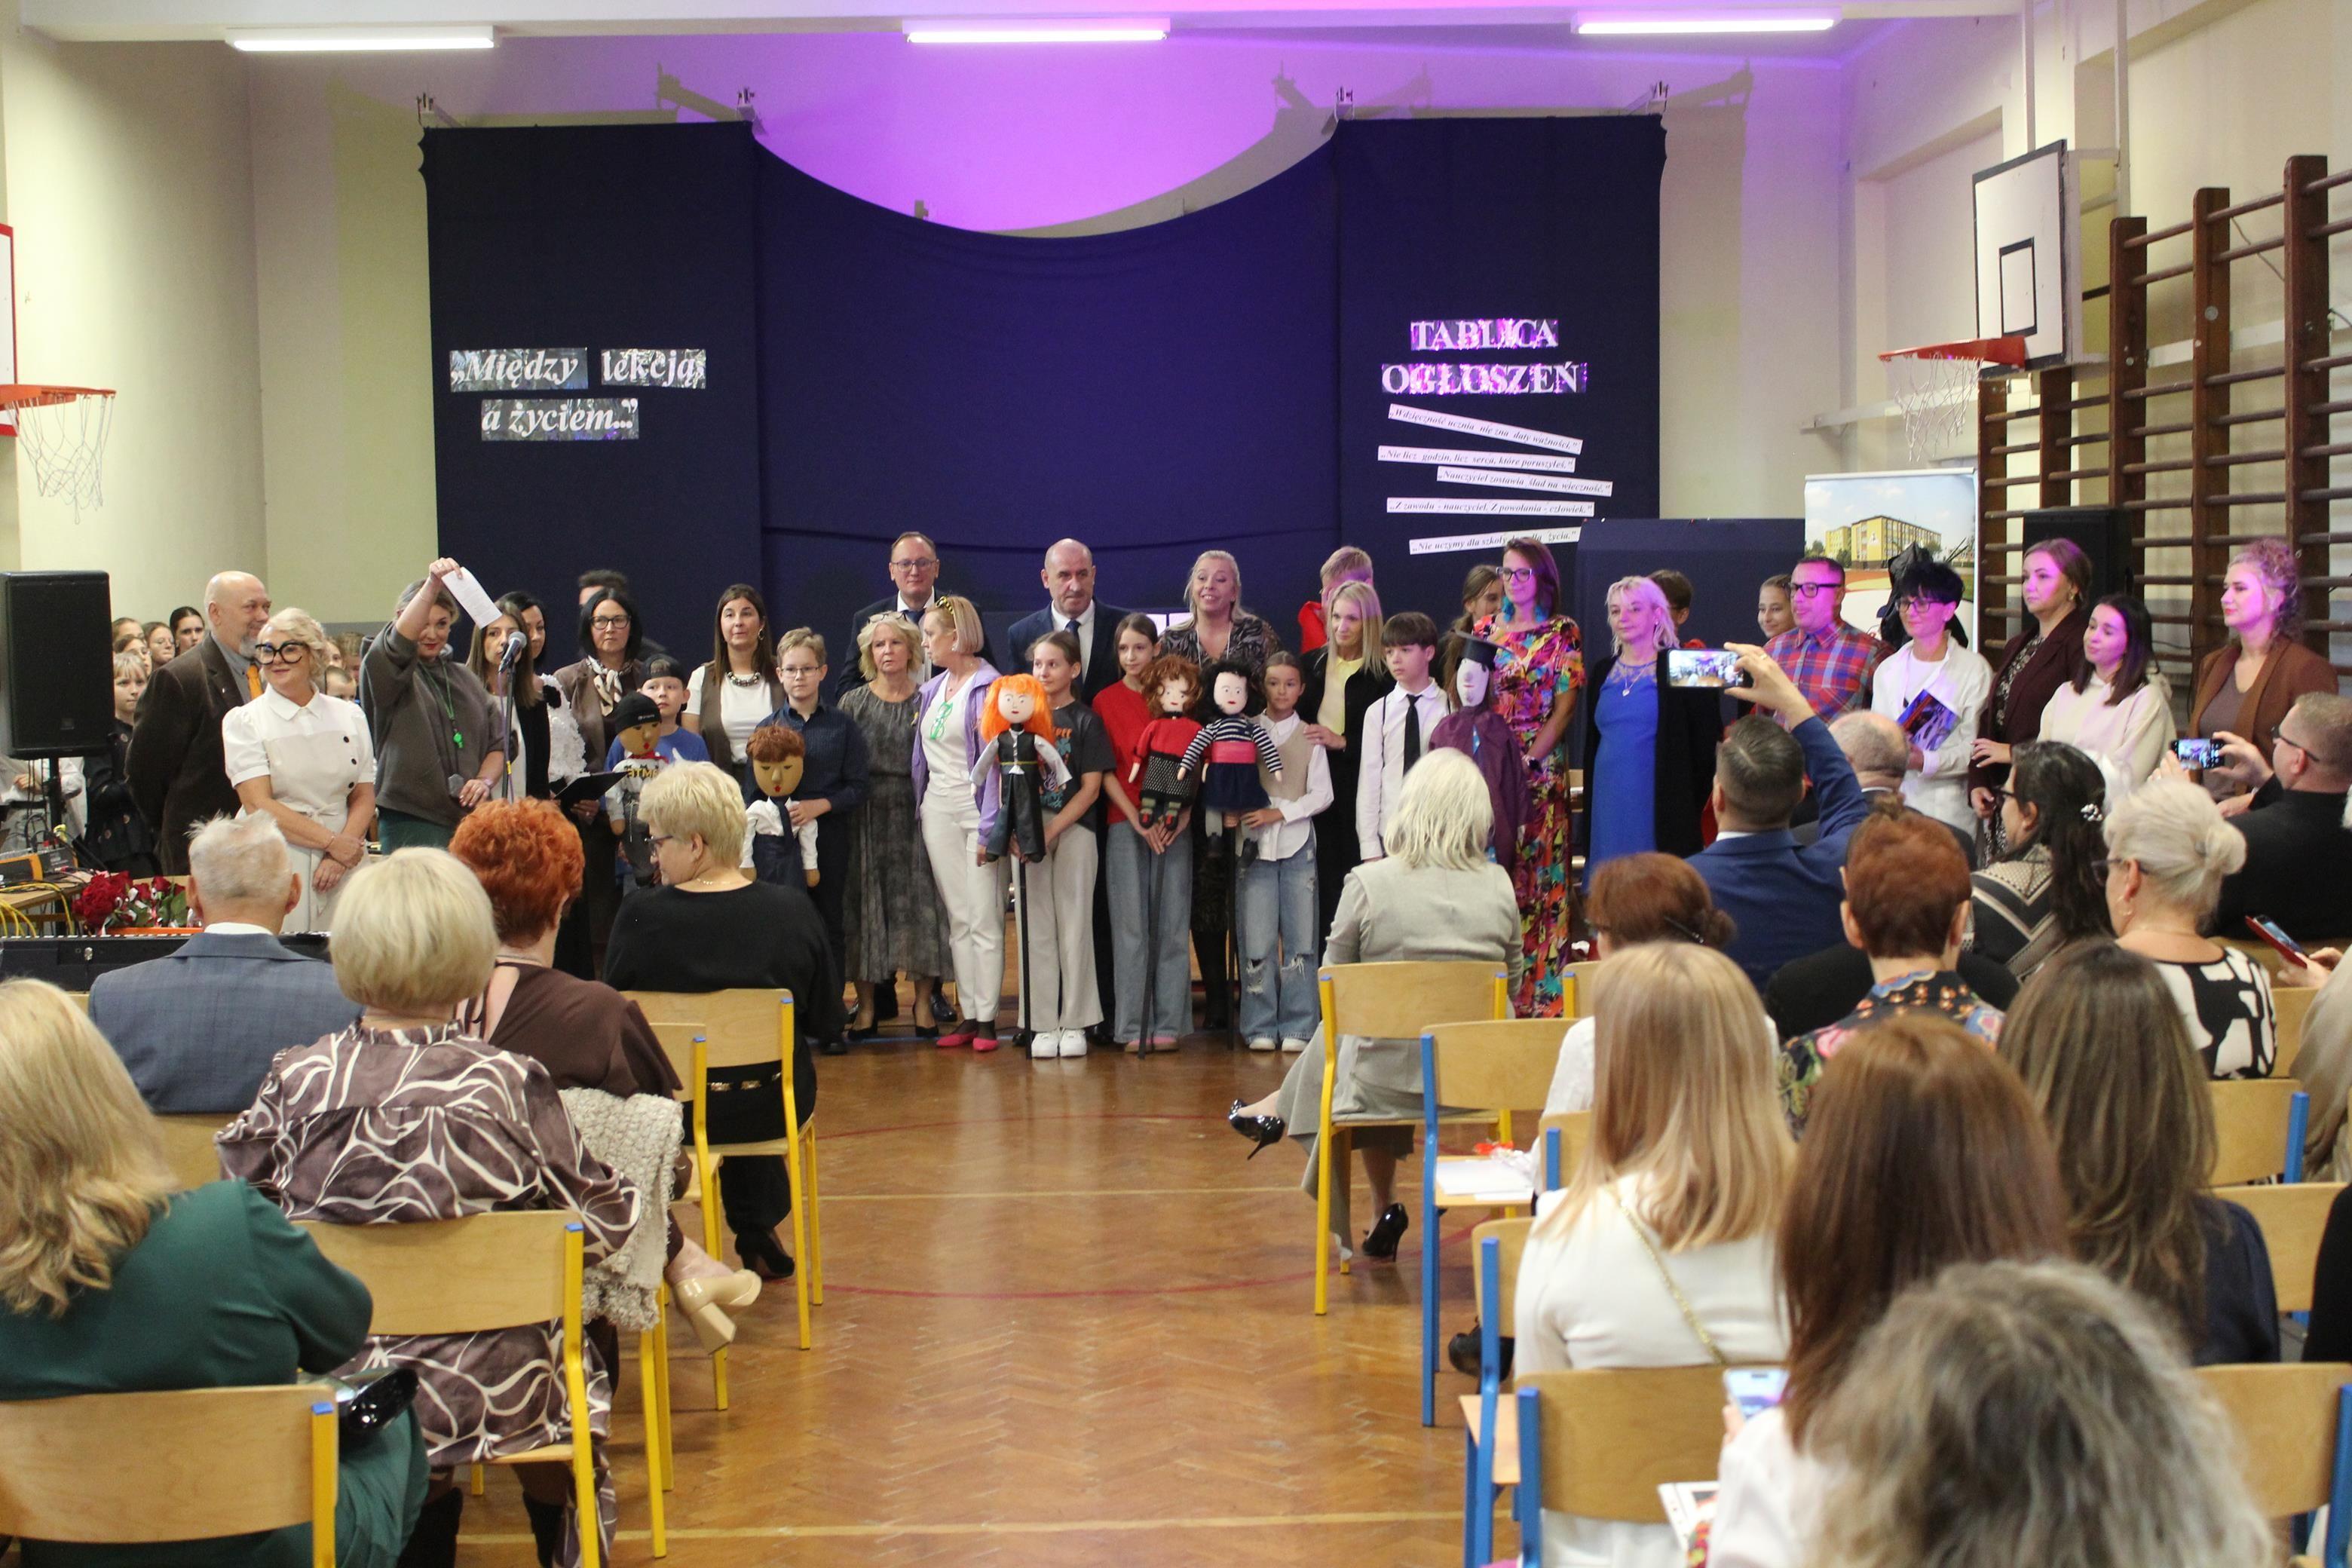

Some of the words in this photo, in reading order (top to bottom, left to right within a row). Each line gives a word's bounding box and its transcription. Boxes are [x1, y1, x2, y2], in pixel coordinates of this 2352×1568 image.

[1410, 319, 1558, 350] TABLICA
[451, 350, 578, 388] „Między
[1382, 361, 1580, 394] OGŁOSZEŃ
[482, 409, 501, 432] a
[1447, 420, 1475, 431] ucznia
[1480, 424, 1493, 435] nie
[1495, 428, 1508, 437] zna
[1513, 430, 1530, 442] daty
[1403, 451, 1416, 459] licz
[1422, 452, 1452, 462] godzin,
[1454, 455, 1468, 463] licz
[1472, 456, 1496, 465] serca,
[1499, 456, 1520, 465] które
[1490, 475, 1524, 485] zostawia
[1529, 477, 1545, 488] ślad
[1404, 501, 1435, 510] zawodu
[1490, 503, 1498, 512] Z
[1499, 503, 1542, 514] powołania
[1435, 541, 1465, 551] uczymy
[1467, 537, 1479, 547] dla
